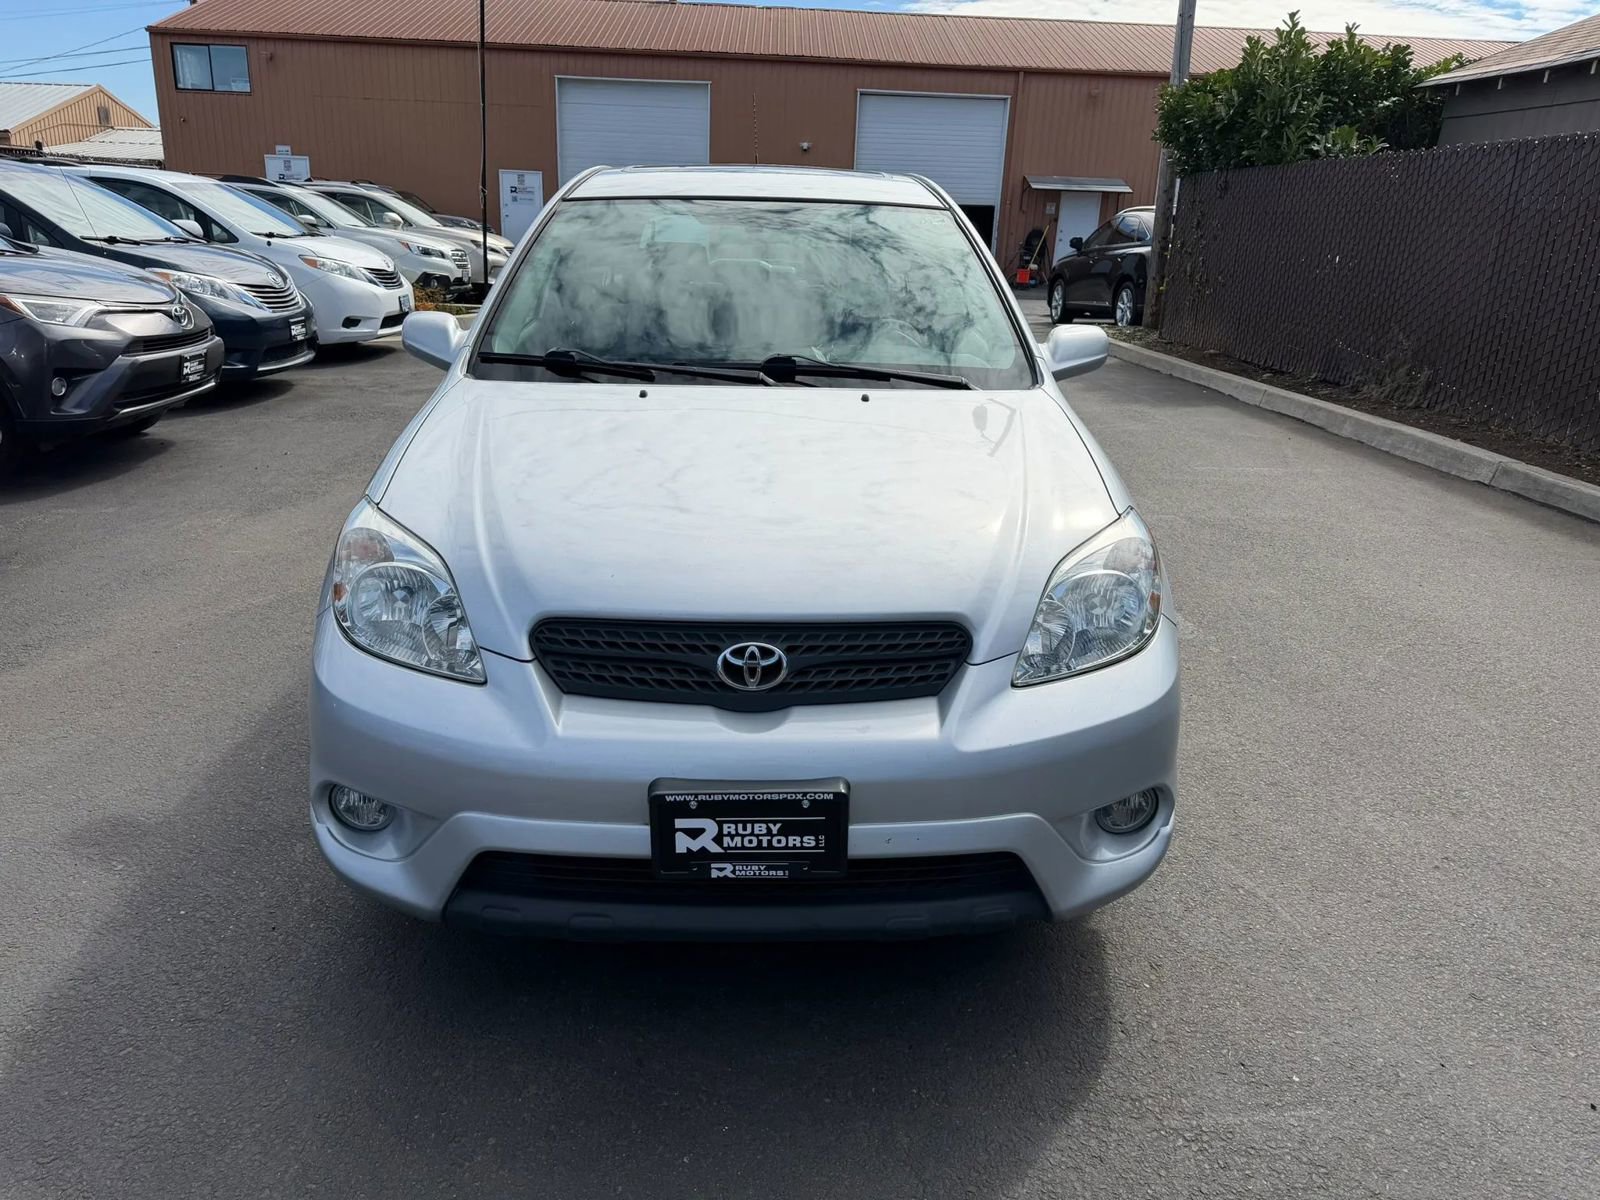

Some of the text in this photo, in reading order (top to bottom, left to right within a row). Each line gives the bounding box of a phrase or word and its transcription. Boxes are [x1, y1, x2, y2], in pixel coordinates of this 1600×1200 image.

[665, 793, 834, 801] WWW.RUBYMOTORSPDX.COM
[723, 823, 782, 834] RUBY
[723, 836, 816, 847] MOTORS
